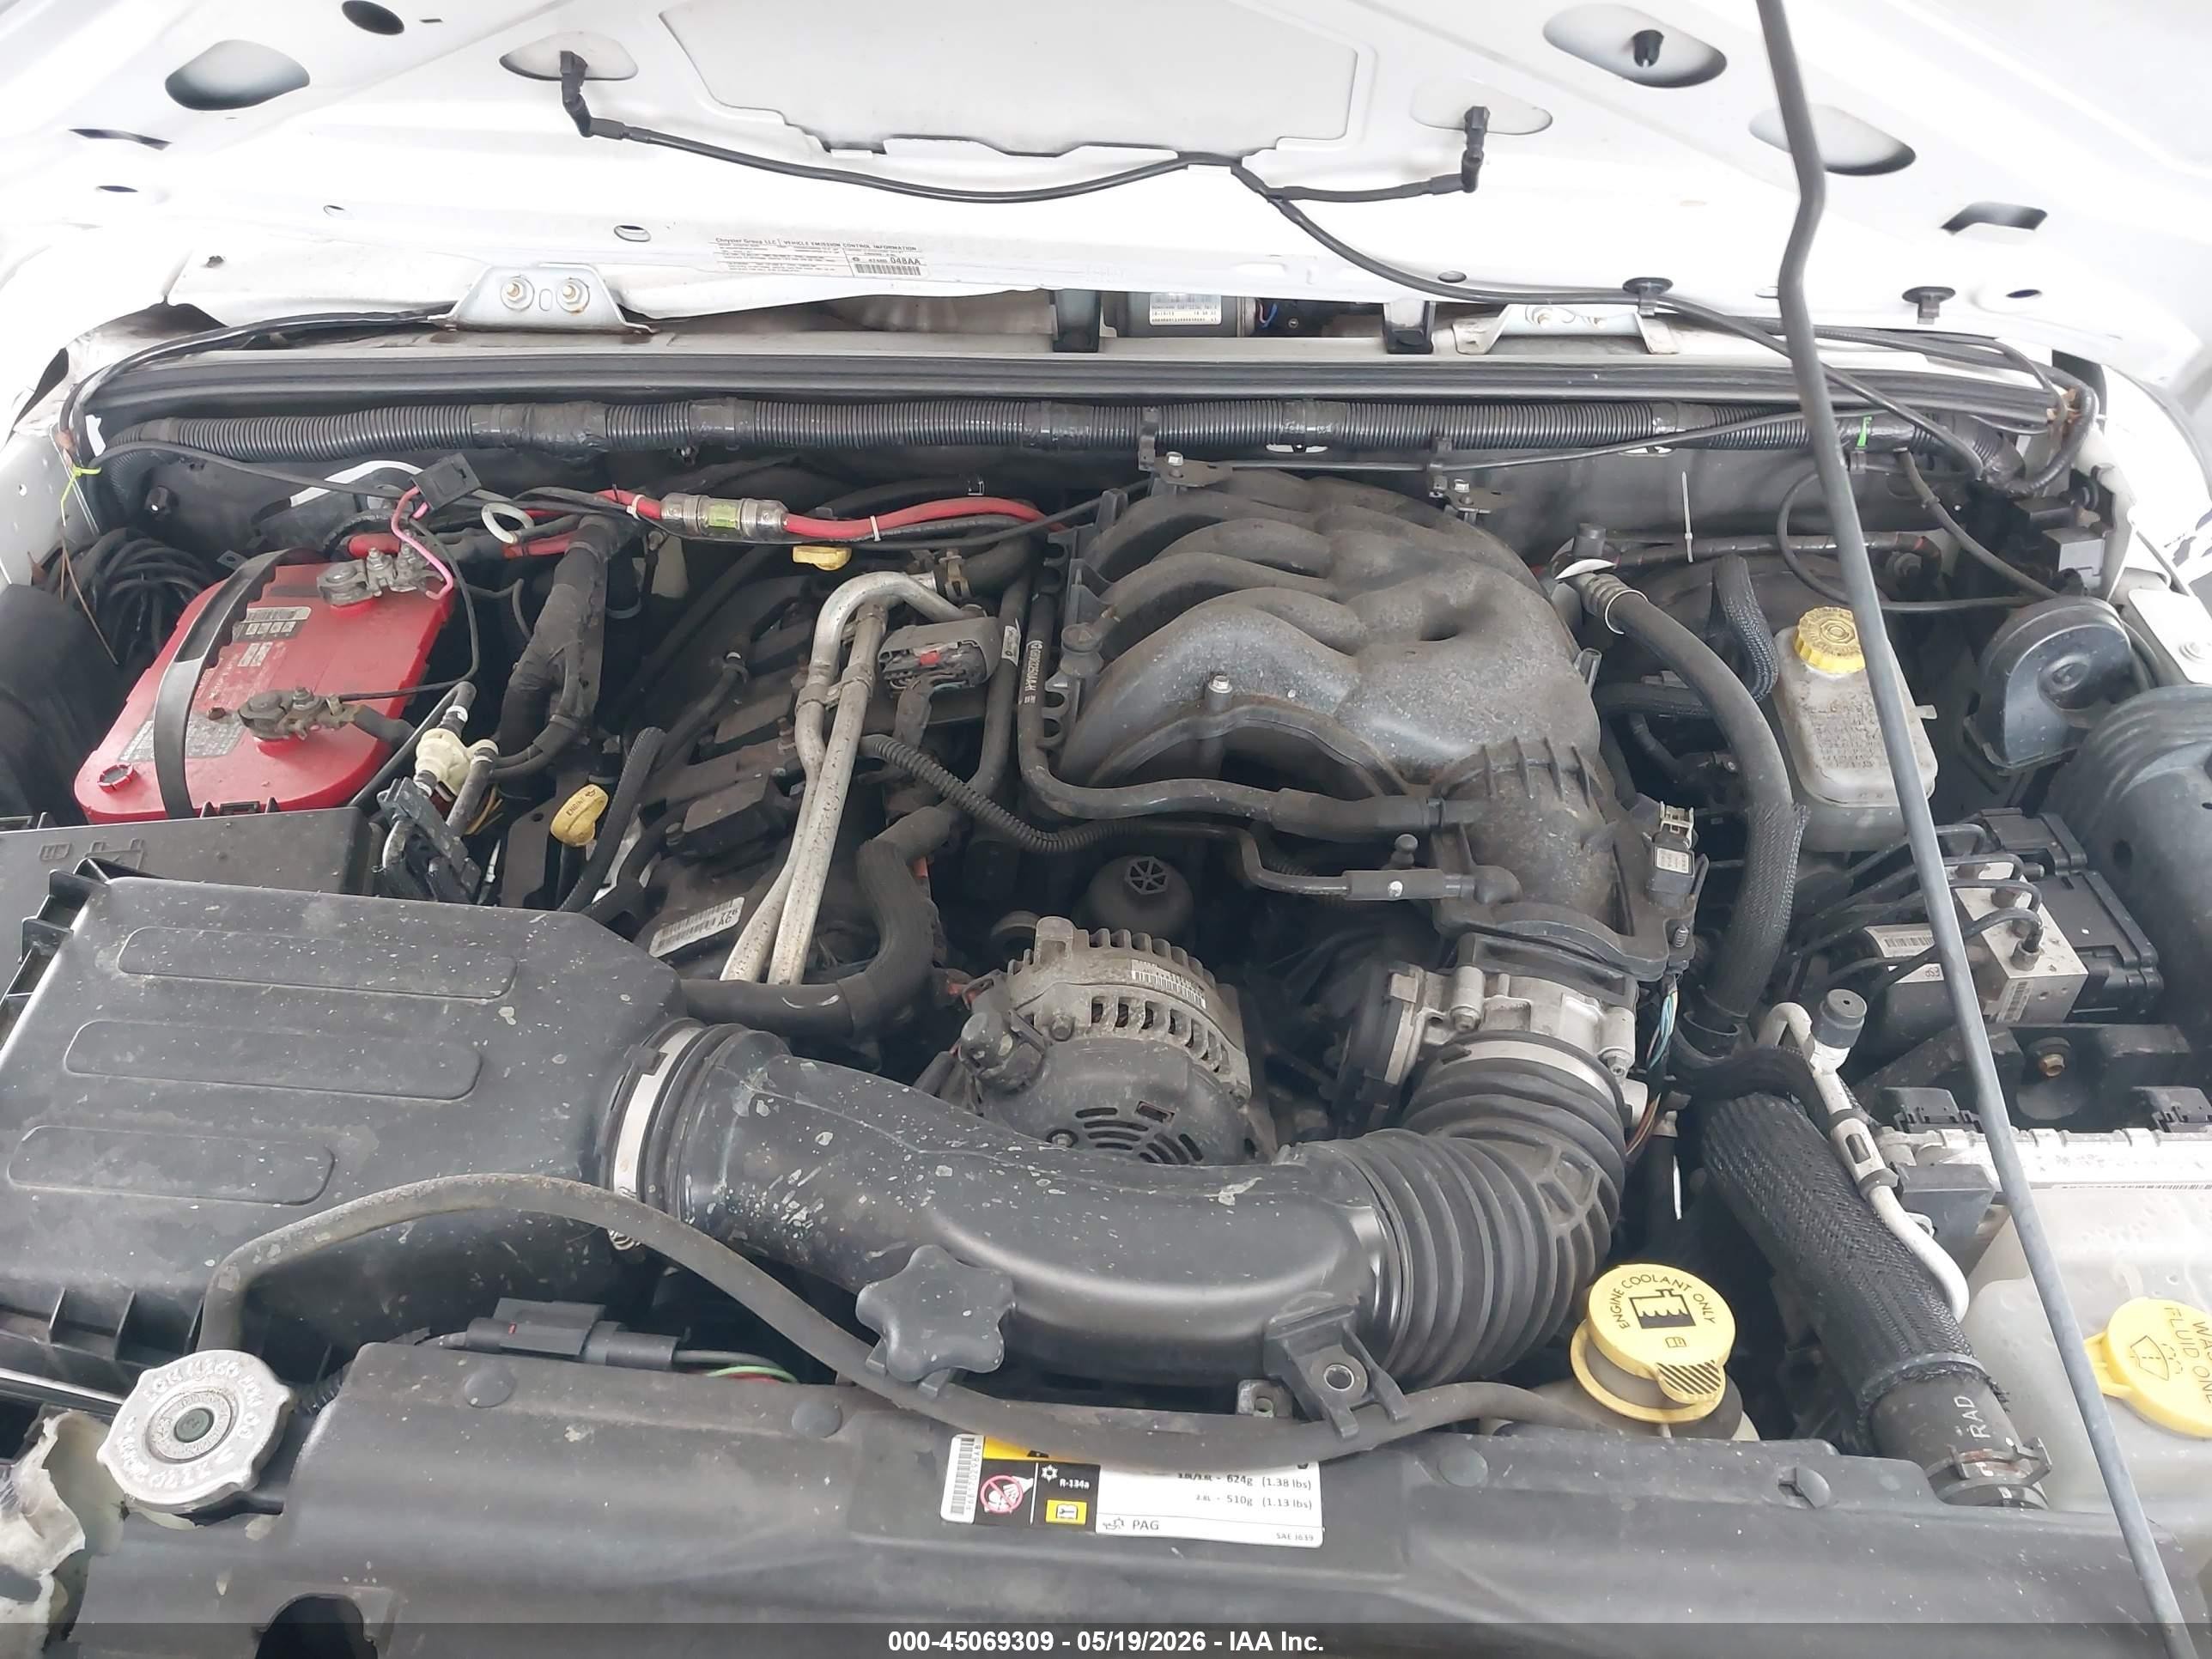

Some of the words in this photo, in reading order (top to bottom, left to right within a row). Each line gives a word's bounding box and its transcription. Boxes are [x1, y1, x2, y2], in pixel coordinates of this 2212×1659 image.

[1608, 1288, 1631, 1329] ENGINE
[1621, 1273, 1692, 1291] COOLANT
[1693, 1293, 1716, 1324] ONLY
[2163, 1307, 2200, 1358] FLUID
[1954, 1395, 1991, 1438] RAD
[1059, 1479, 1091, 1490] R-134a
[1226, 1474, 1253, 1486] 624g
[1261, 1476, 1289, 1488] (1.38
[1292, 1479, 1312, 1491] lbs)
[1226, 1494, 1253, 1507] 510g
[1262, 1497, 1290, 1508] (1.13
[1292, 1498, 1312, 1510] lbs)
[1132, 1519, 1160, 1530] PAG
[1276, 1532, 1292, 1540] SAE
